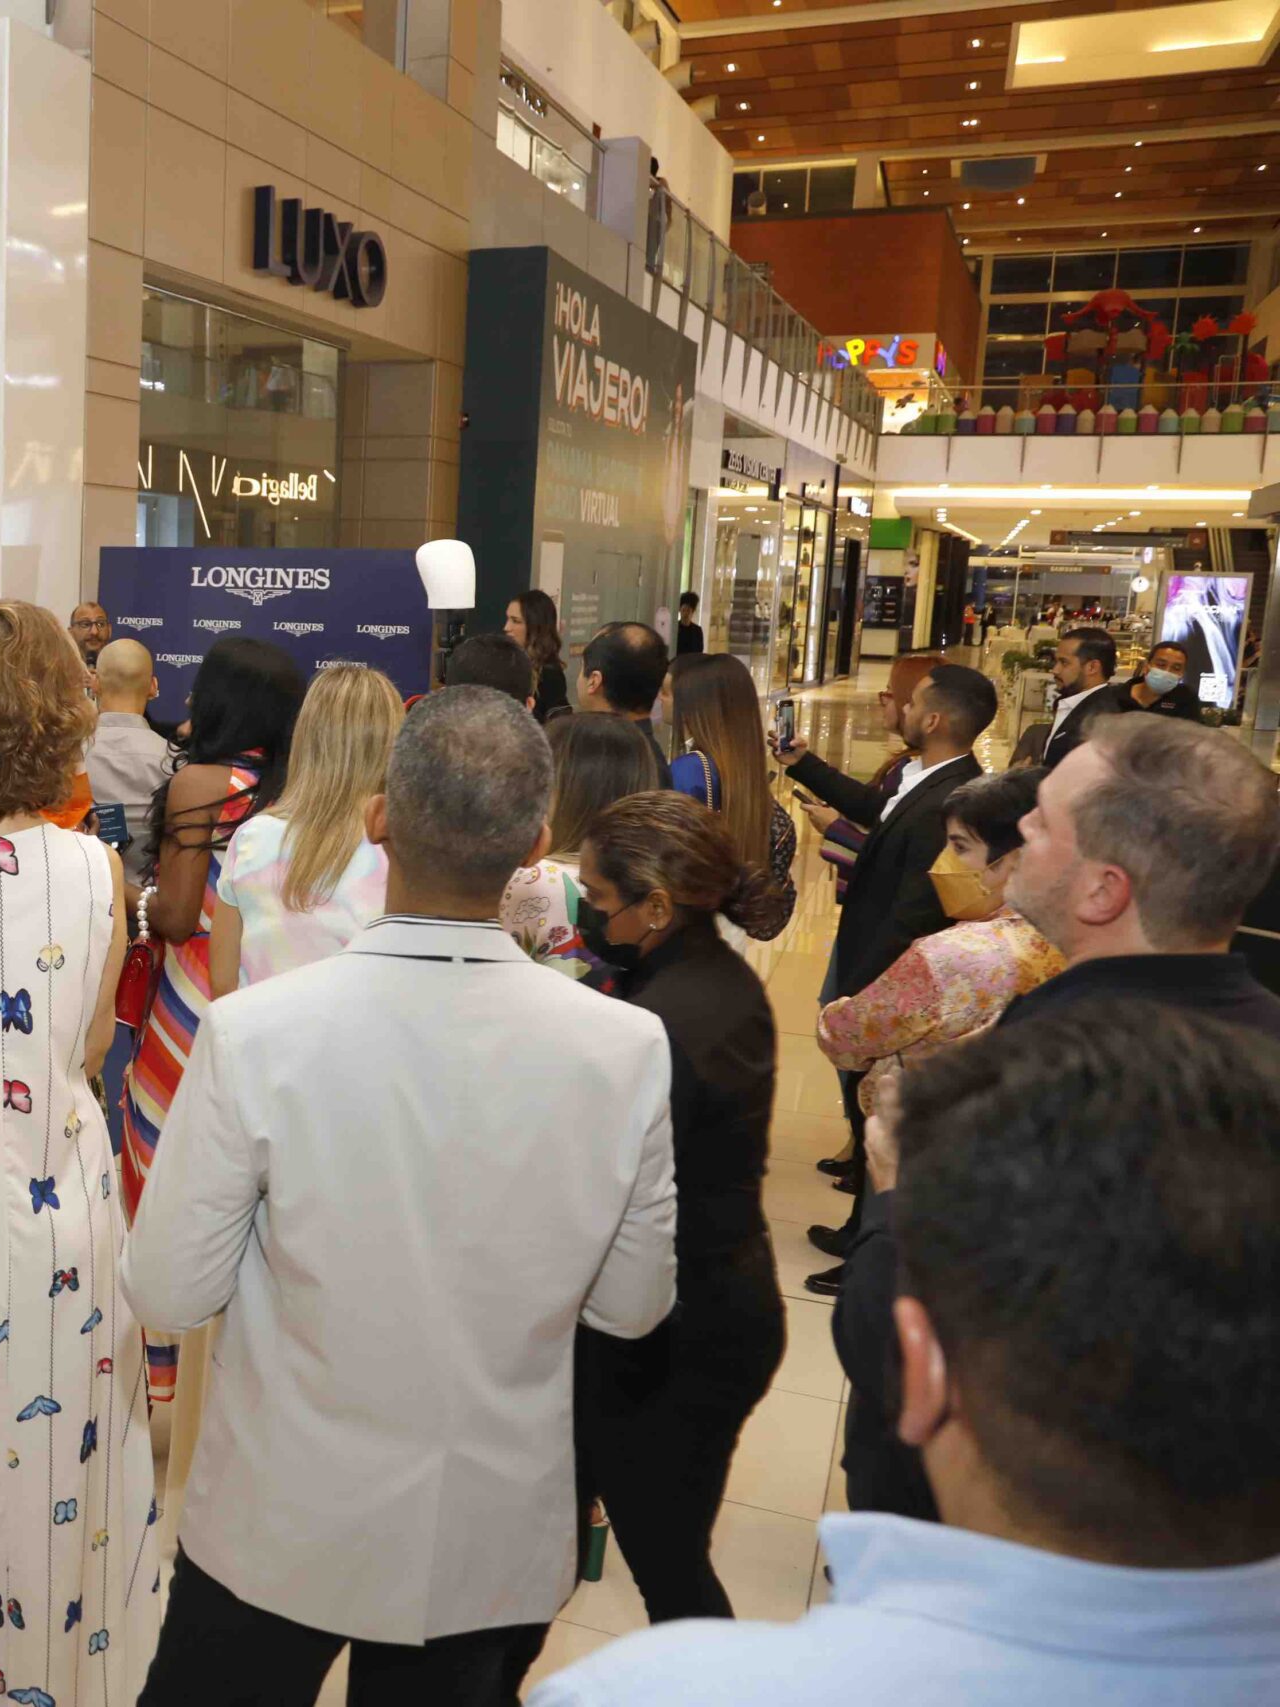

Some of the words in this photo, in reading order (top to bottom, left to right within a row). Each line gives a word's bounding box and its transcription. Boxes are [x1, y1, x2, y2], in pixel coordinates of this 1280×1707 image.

[253, 184, 388, 308] LUXO
[553, 334, 650, 434] VIAJERO!
[580, 488, 620, 528] VIRTUAL
[191, 566, 331, 590] LONGINES
[117, 617, 163, 627] LONGINES
[193, 619, 241, 630] LONGINES
[273, 621, 324, 633] LONGINES
[356, 624, 410, 636] LONGINES
[156, 653, 204, 665] LONGINES
